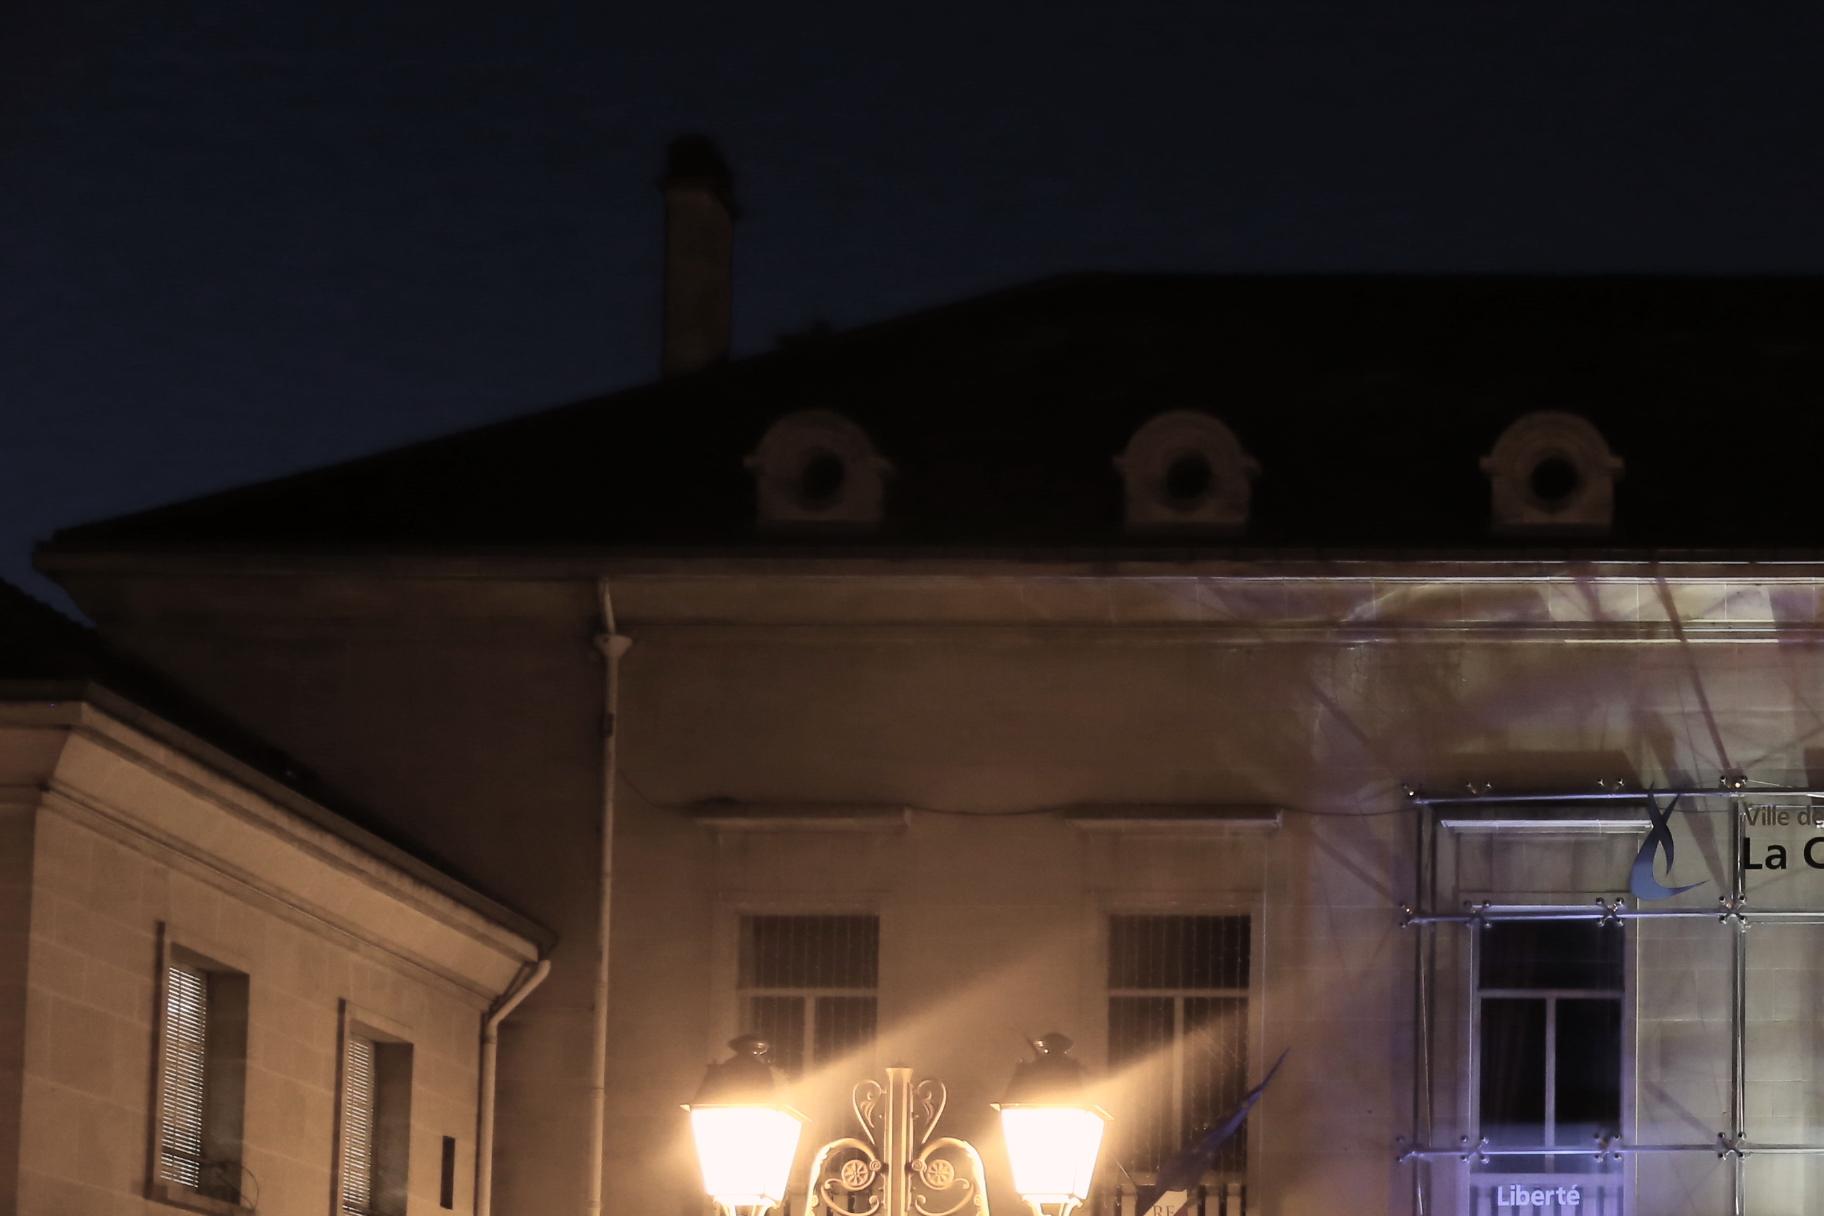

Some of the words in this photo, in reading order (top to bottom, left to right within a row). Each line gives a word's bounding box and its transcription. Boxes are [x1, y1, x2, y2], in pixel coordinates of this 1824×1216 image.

[1744, 803, 1790, 826] Ville
[1797, 804, 1824, 826] de
[1743, 837, 1787, 870] La
[1498, 1184, 1581, 1206] Liberté
